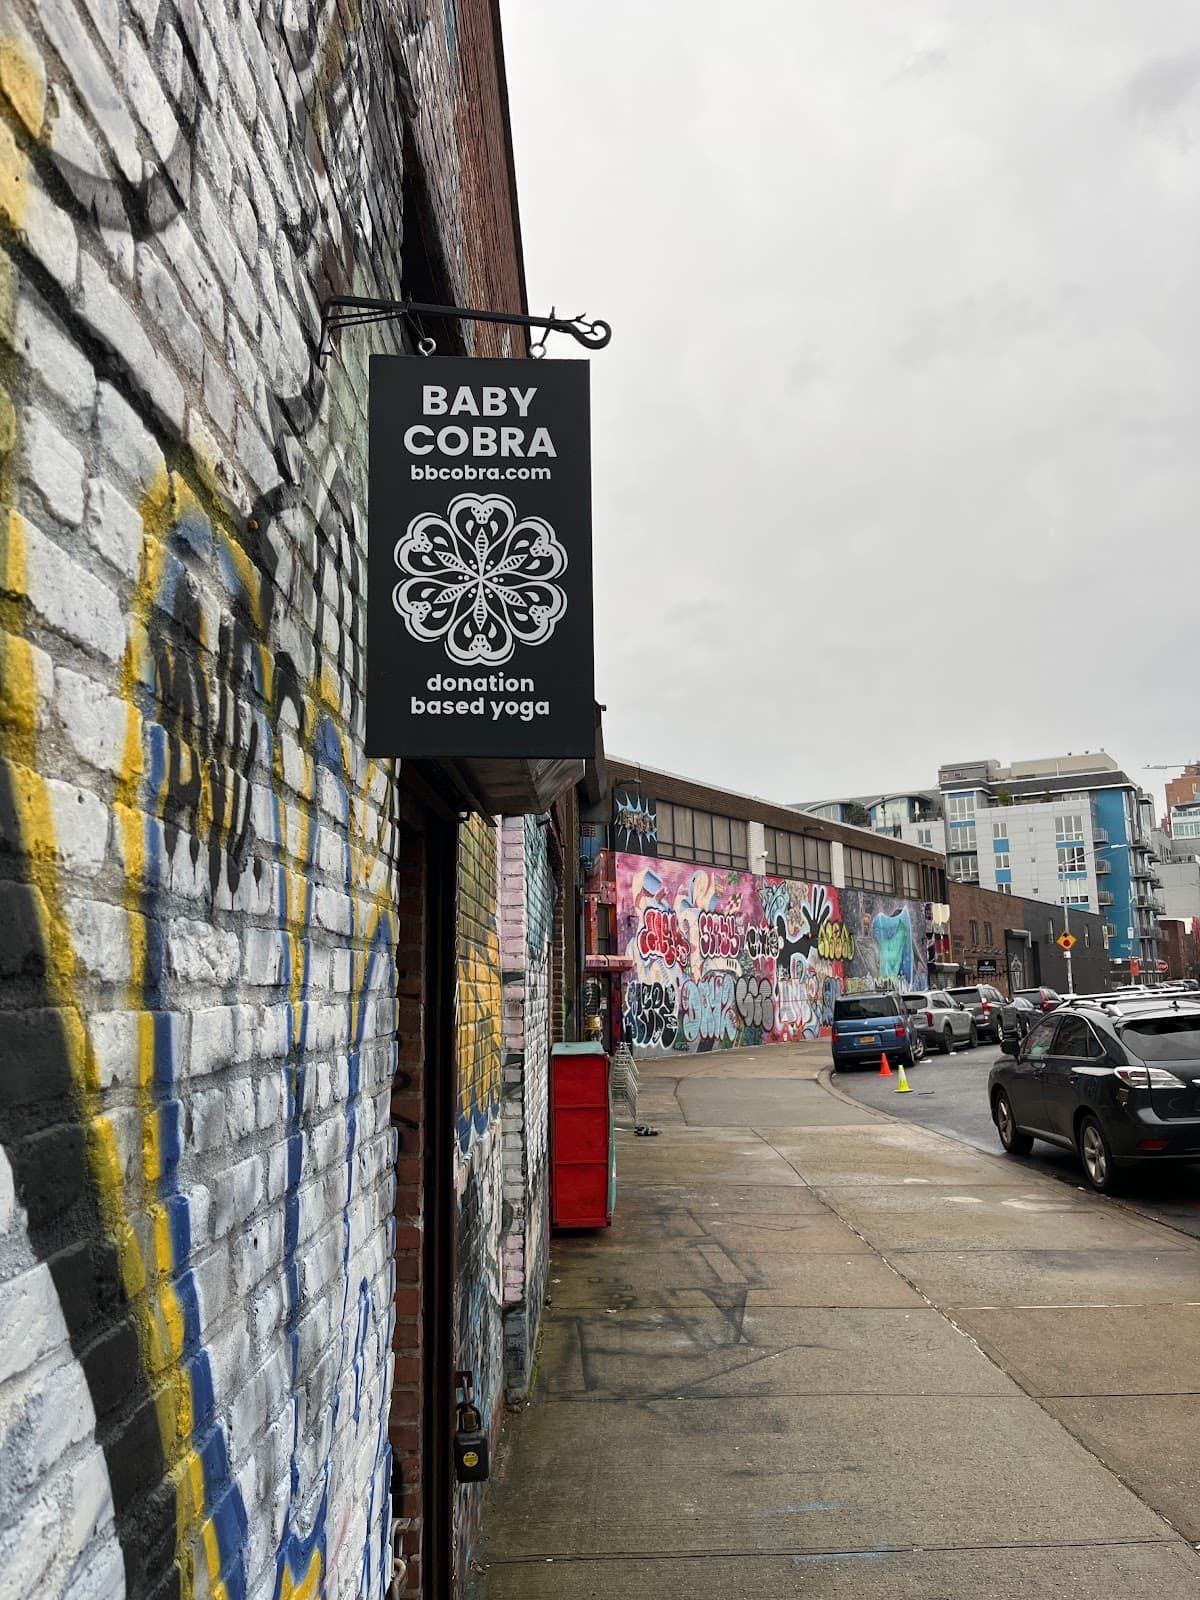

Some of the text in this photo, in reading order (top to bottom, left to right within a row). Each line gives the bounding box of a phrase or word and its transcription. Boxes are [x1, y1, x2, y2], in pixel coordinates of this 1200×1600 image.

[422, 385, 538, 417] BABY
[403, 424, 557, 458] COBRA
[410, 464, 552, 481] bbcobra.com
[426, 672, 535, 692] donation
[410, 696, 550, 722] based yoga
